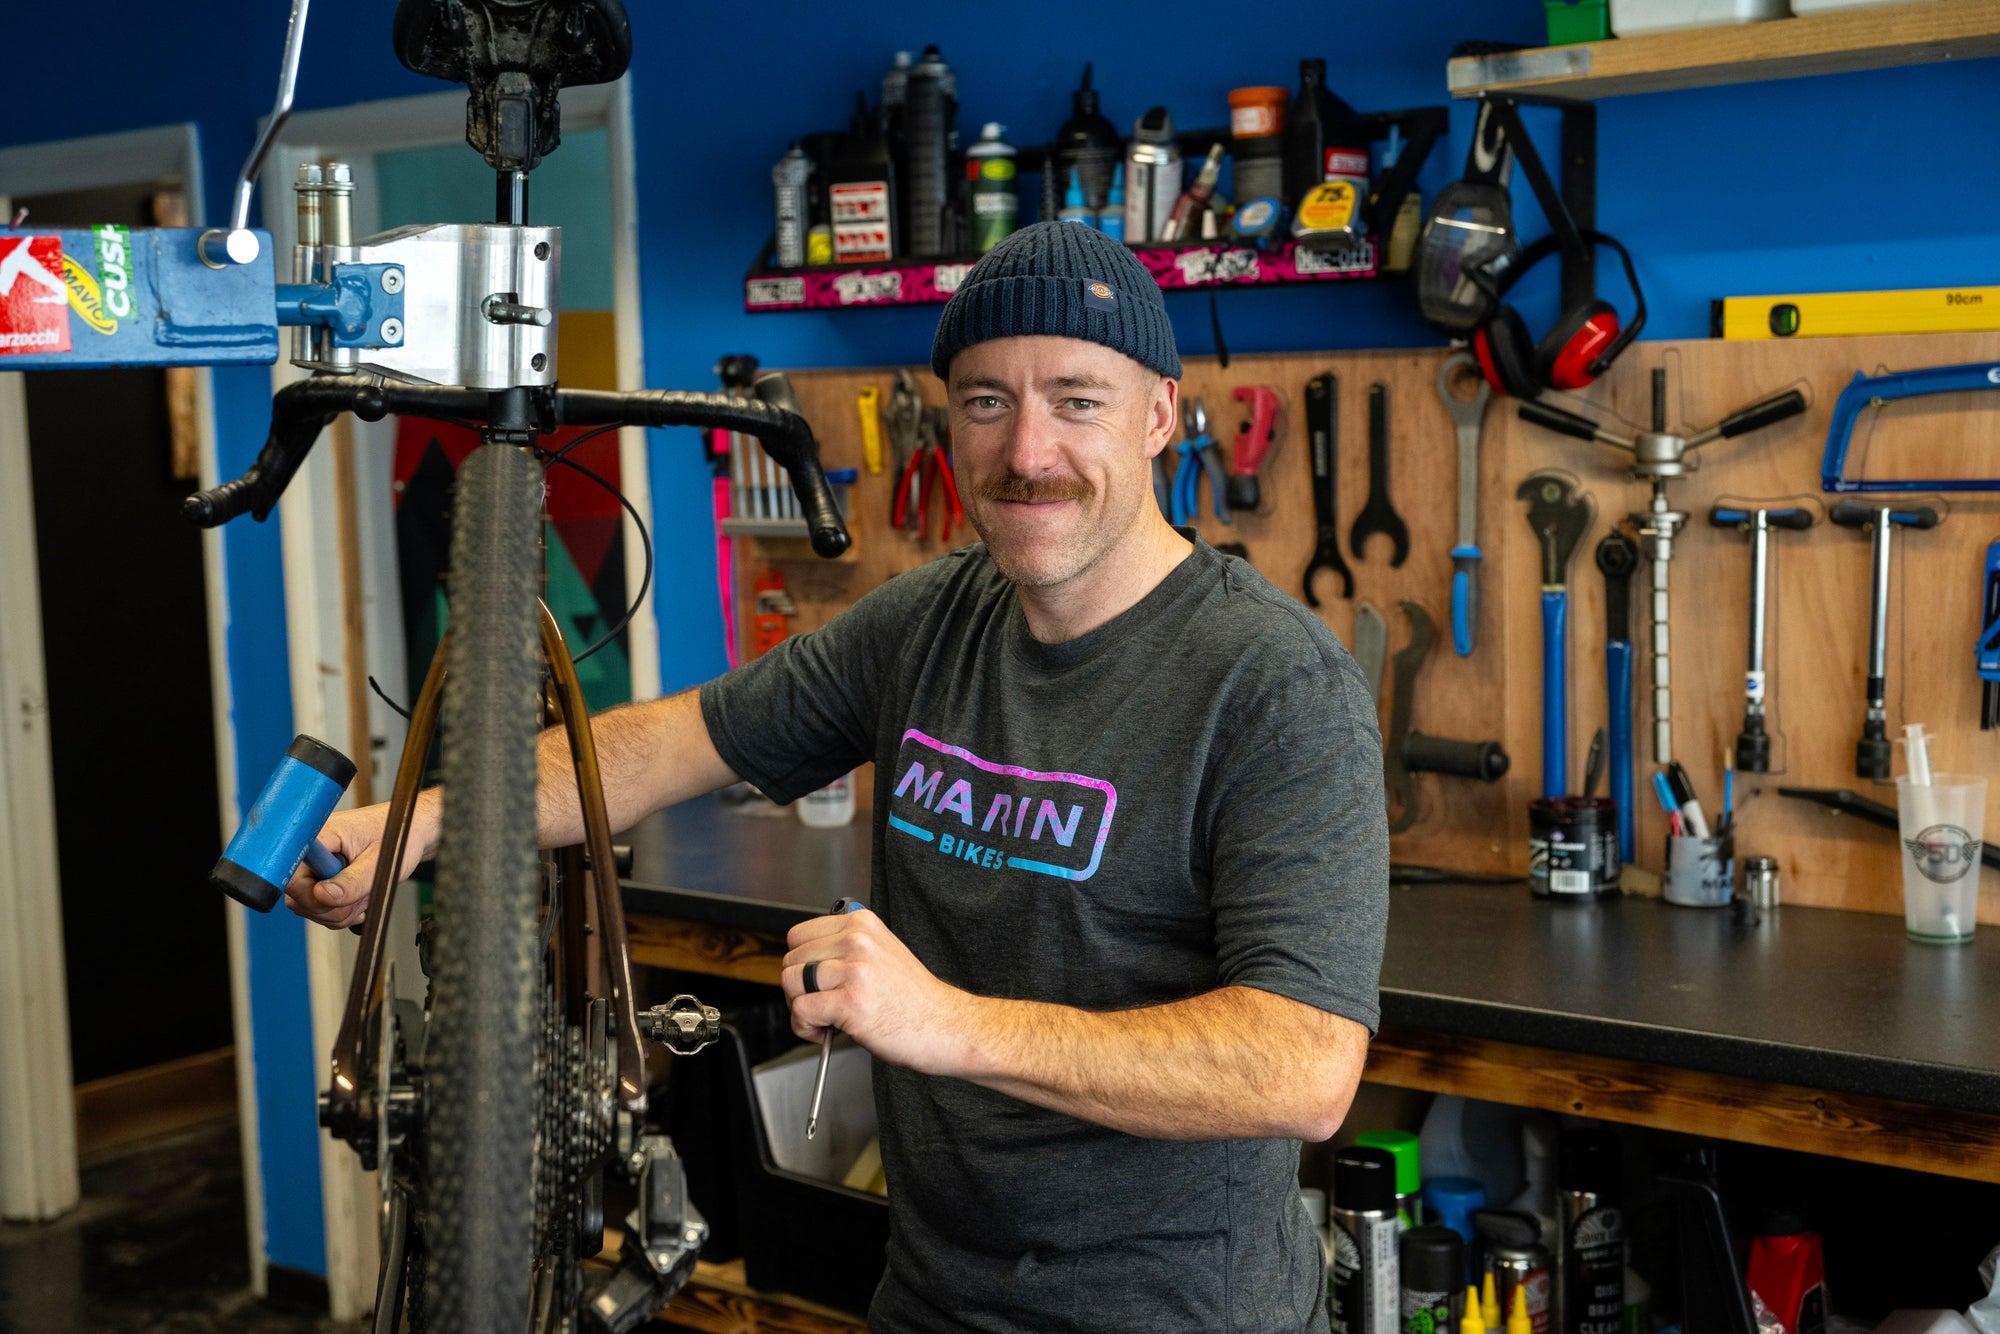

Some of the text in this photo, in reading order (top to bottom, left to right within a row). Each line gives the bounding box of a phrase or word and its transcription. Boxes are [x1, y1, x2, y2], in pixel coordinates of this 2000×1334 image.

[1945, 292, 1983, 306] 90cm
[894, 761, 1084, 847] MARIN
[938, 833, 1004, 870] BIKES
